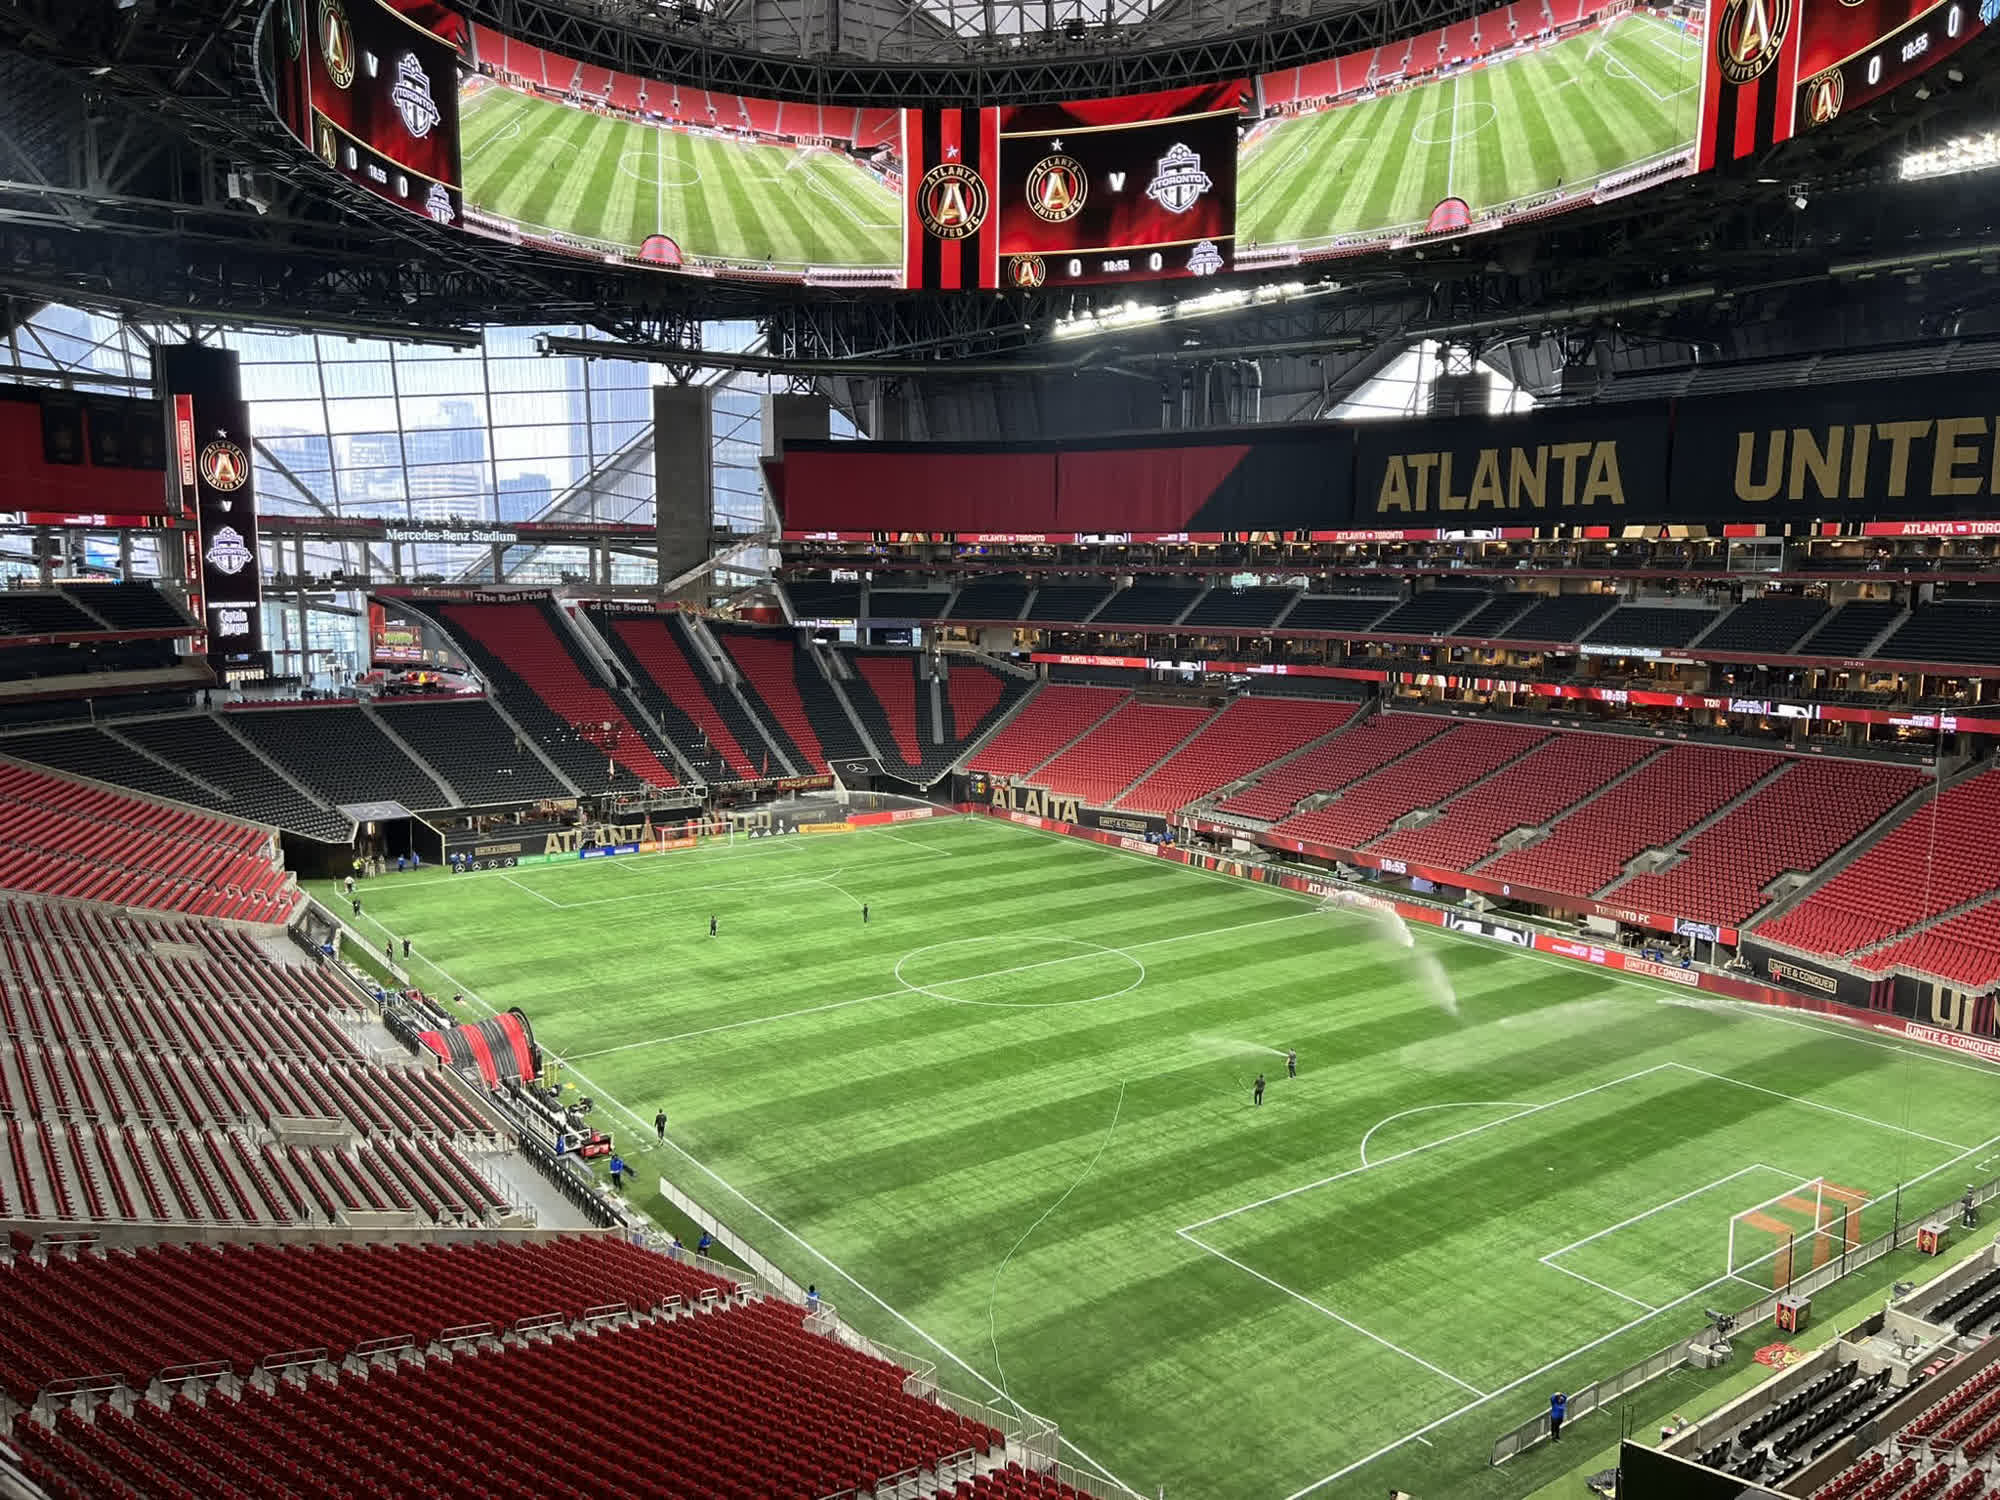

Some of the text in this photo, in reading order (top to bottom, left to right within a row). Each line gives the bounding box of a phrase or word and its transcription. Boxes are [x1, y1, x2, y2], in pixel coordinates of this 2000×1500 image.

[1948, 6, 1959, 37] 0
[1901, 33, 1928, 62] 18:55
[1724, 35, 1780, 79] UNITED FC
[1868, 56, 1881, 85] 0
[349, 147, 358, 170] 0
[1036, 157, 1078, 175] ATLANTA
[368, 164, 387, 184] 18:55
[927, 166, 977, 185] ATLANTA
[1157, 175, 1202, 188] TORONTO
[400, 176, 408, 198] 0
[1034, 199, 1080, 220] UNITED FC
[924, 215, 980, 237] UNITED FC
[1069, 259, 1082, 277] 0
[1103, 259, 1130, 272] 18:55
[1151, 252, 1162, 271] 0
[207, 443, 240, 455] ATLANTA
[1734, 416, 2000, 502] UNITE
[208, 474, 234, 489] UNITED
[1377, 440, 1625, 512] ATLANTA
[386, 528, 517, 542] Mercedes-Benz Stadium
[1336, 531, 1366, 540] ATLANTA
[1375, 531, 1404, 540] TORONTO
[1902, 522, 1953, 534] ATLANTA
[1970, 522, 2000, 534] TORO
[979, 534, 1007, 542] ATLANTA
[1016, 534, 1045, 542] TORONTO
[475, 591, 549, 603] The Real Pride
[590, 602, 655, 613] of the South
[1555, 686, 1561, 696] 0
[1601, 689, 1628, 702] 18:55
[1676, 696, 1682, 706] 0
[1298, 842, 1304, 852] 0
[1380, 858, 1407, 874] 18:55
[1307, 882, 1340, 898] ATLANT
[1503, 884, 1510, 896] 0
[1595, 904, 1650, 924] TONTO FC
[1626, 958, 1696, 983] UNITE & CONQUER
[1770, 960, 1834, 990] UNITE & CONQUER
[1909, 1026, 2000, 1057] UNITE & CONQUER
